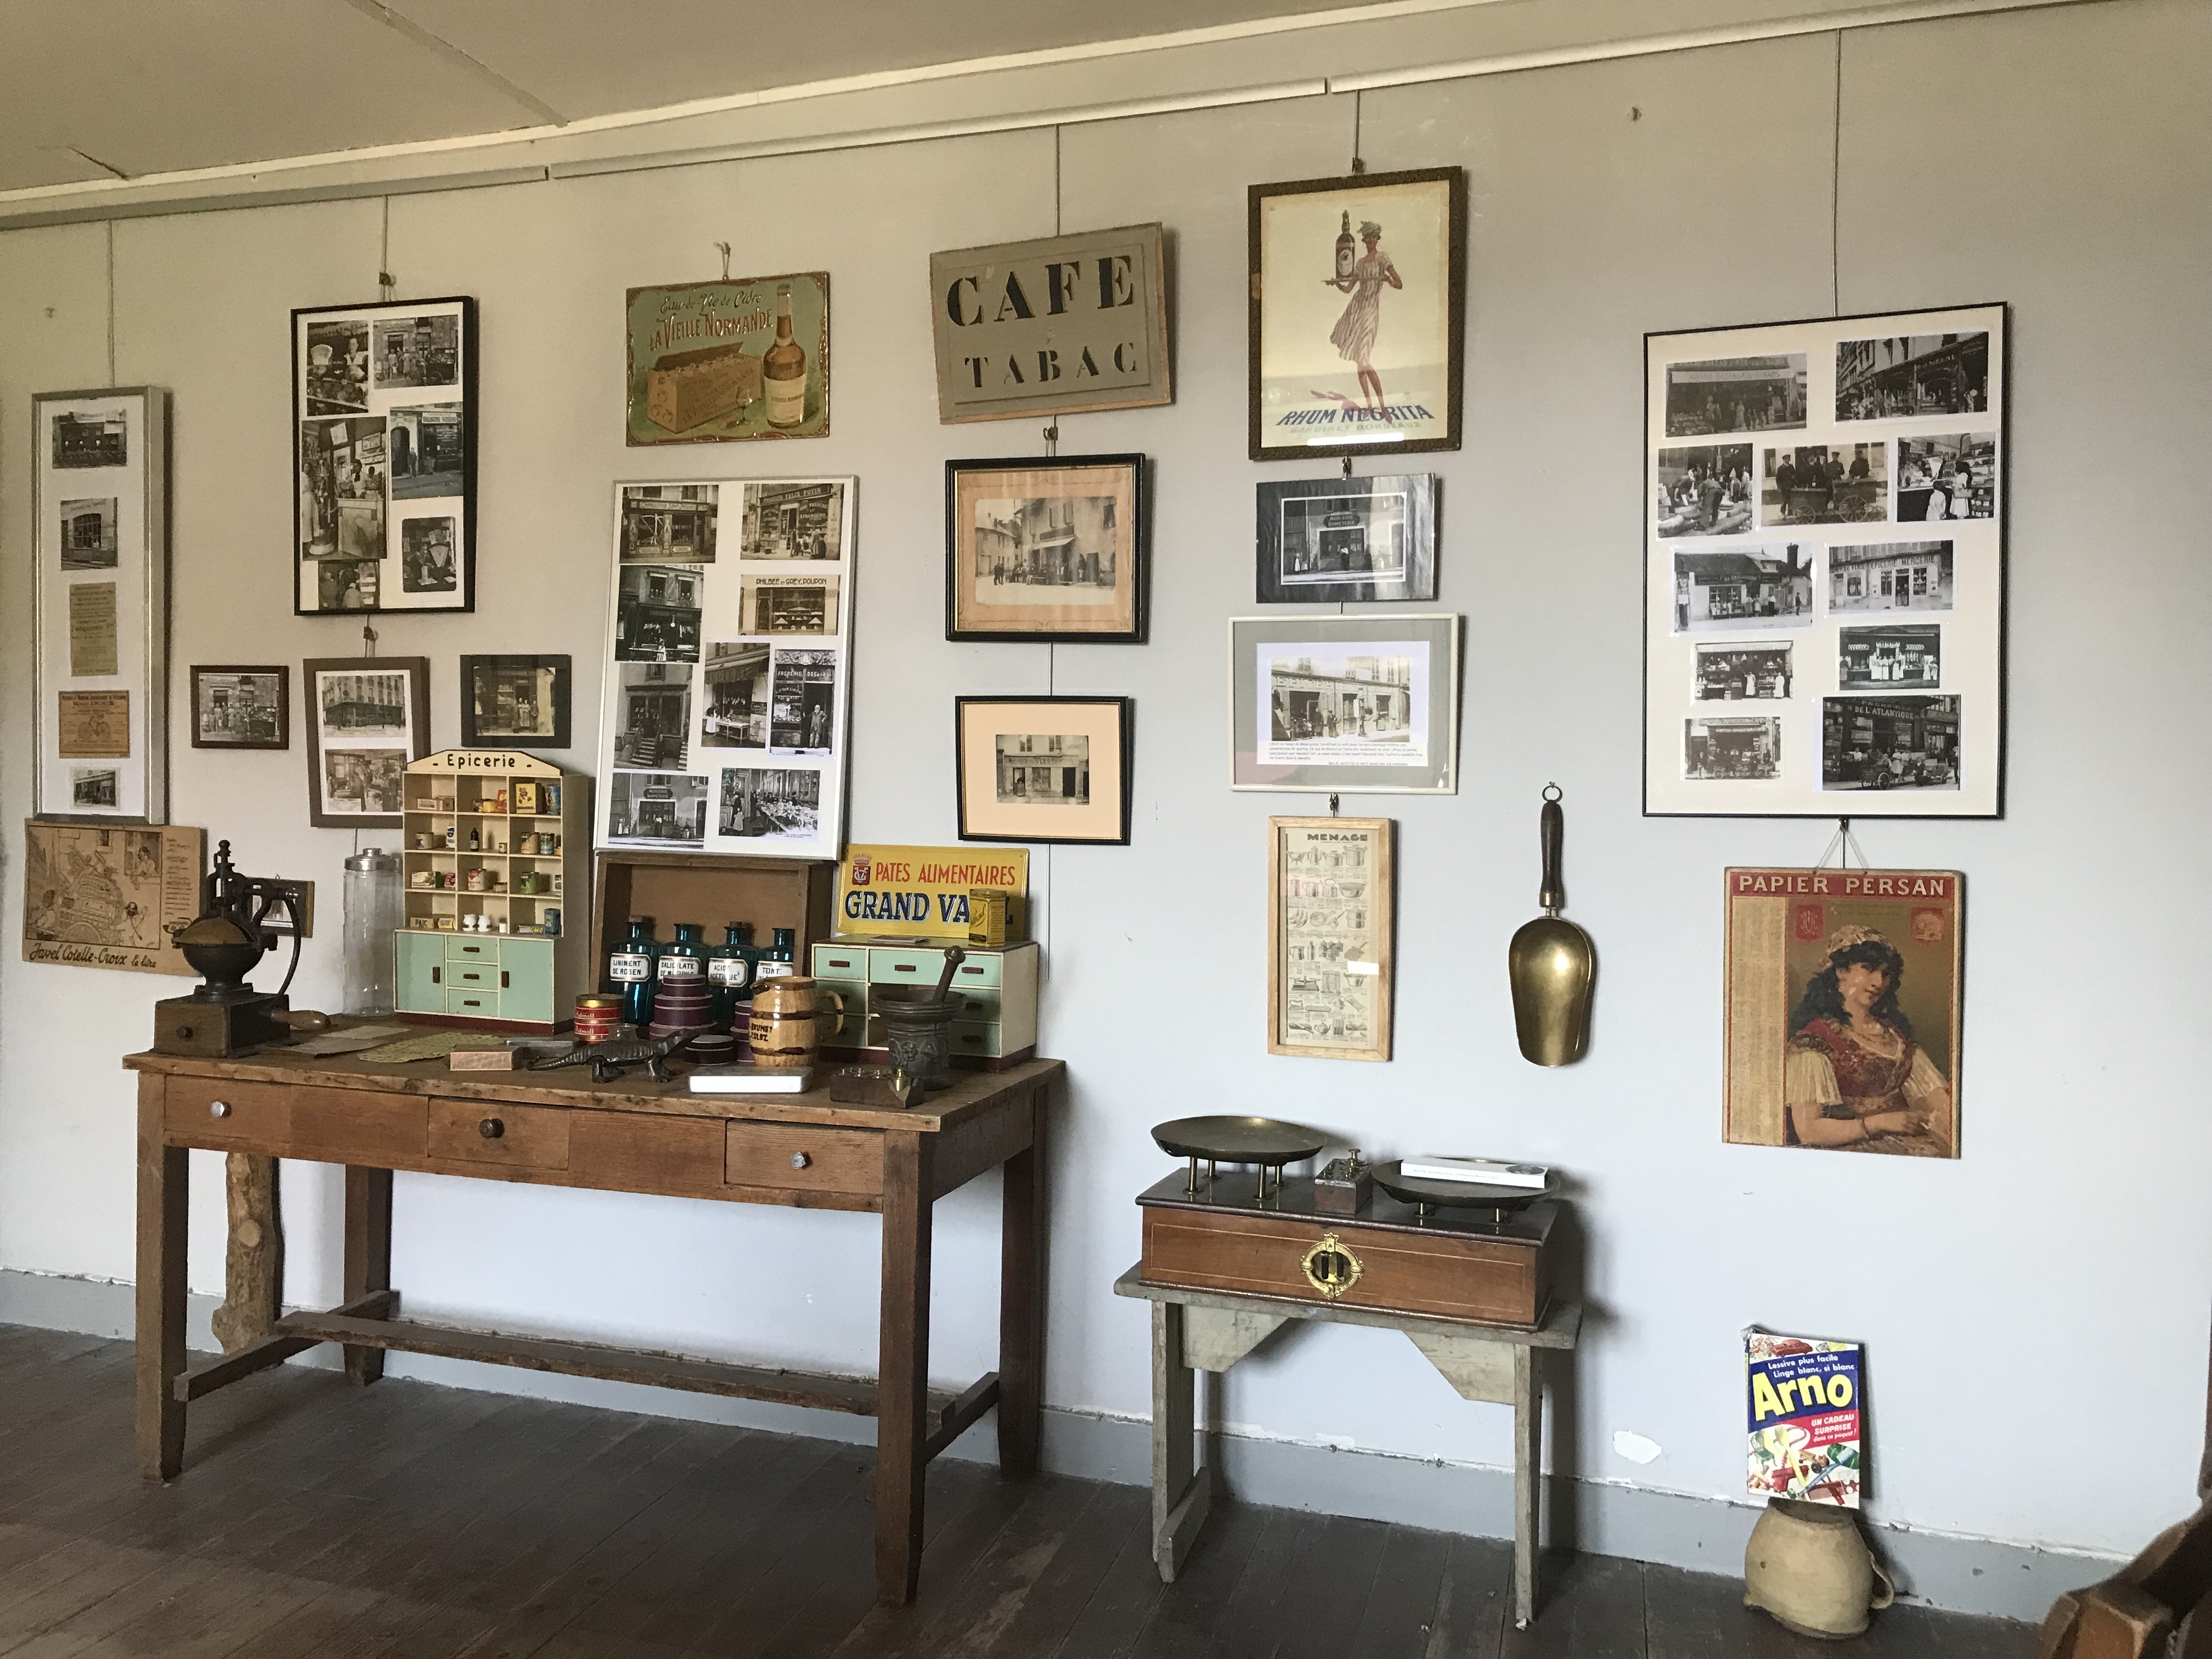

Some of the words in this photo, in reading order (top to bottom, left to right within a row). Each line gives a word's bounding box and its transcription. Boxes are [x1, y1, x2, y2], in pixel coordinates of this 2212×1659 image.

[720, 293, 730, 306] de
[733, 289, 763, 308] Cidre
[946, 255, 1133, 327] CAFE
[650, 330, 662, 351] LA
[656, 313, 702, 349] VIEILLE
[698, 307, 773, 337] NORMANDE
[964, 341, 1137, 388] TABAC
[1276, 409, 1338, 426] RHUM
[1340, 404, 1436, 424] NEGRITA
[1356, 421, 1421, 431] BORDEAUX
[1871, 708, 1914, 719] ATLANTIQUE
[447, 753, 515, 770] Epicerie
[1307, 833, 1368, 842] MENAGE
[875, 862, 911, 883] PATES
[917, 864, 1015, 886] ALIMENTAIRES
[1739, 875, 1829, 894] PAPIER
[1845, 877, 1944, 896] PERSAN
[845, 890, 930, 922] GRAND
[29, 941, 63, 961] Javel
[1768, 1361, 1796, 1370] Lessive
[1798, 1357, 1814, 1367] plus
[1816, 1354, 1838, 1363] facile
[1773, 1370, 1795, 1379] Linge
[1797, 1366, 1822, 1375] blanc,
[1832, 1363, 1855, 1371] blanc
[1752, 1372, 1853, 1422] Arno
[1811, 1418, 1822, 1427] UN
[1823, 1413, 1855, 1425] CADEAU
[1814, 1423, 1852, 1435] SURPRISE
